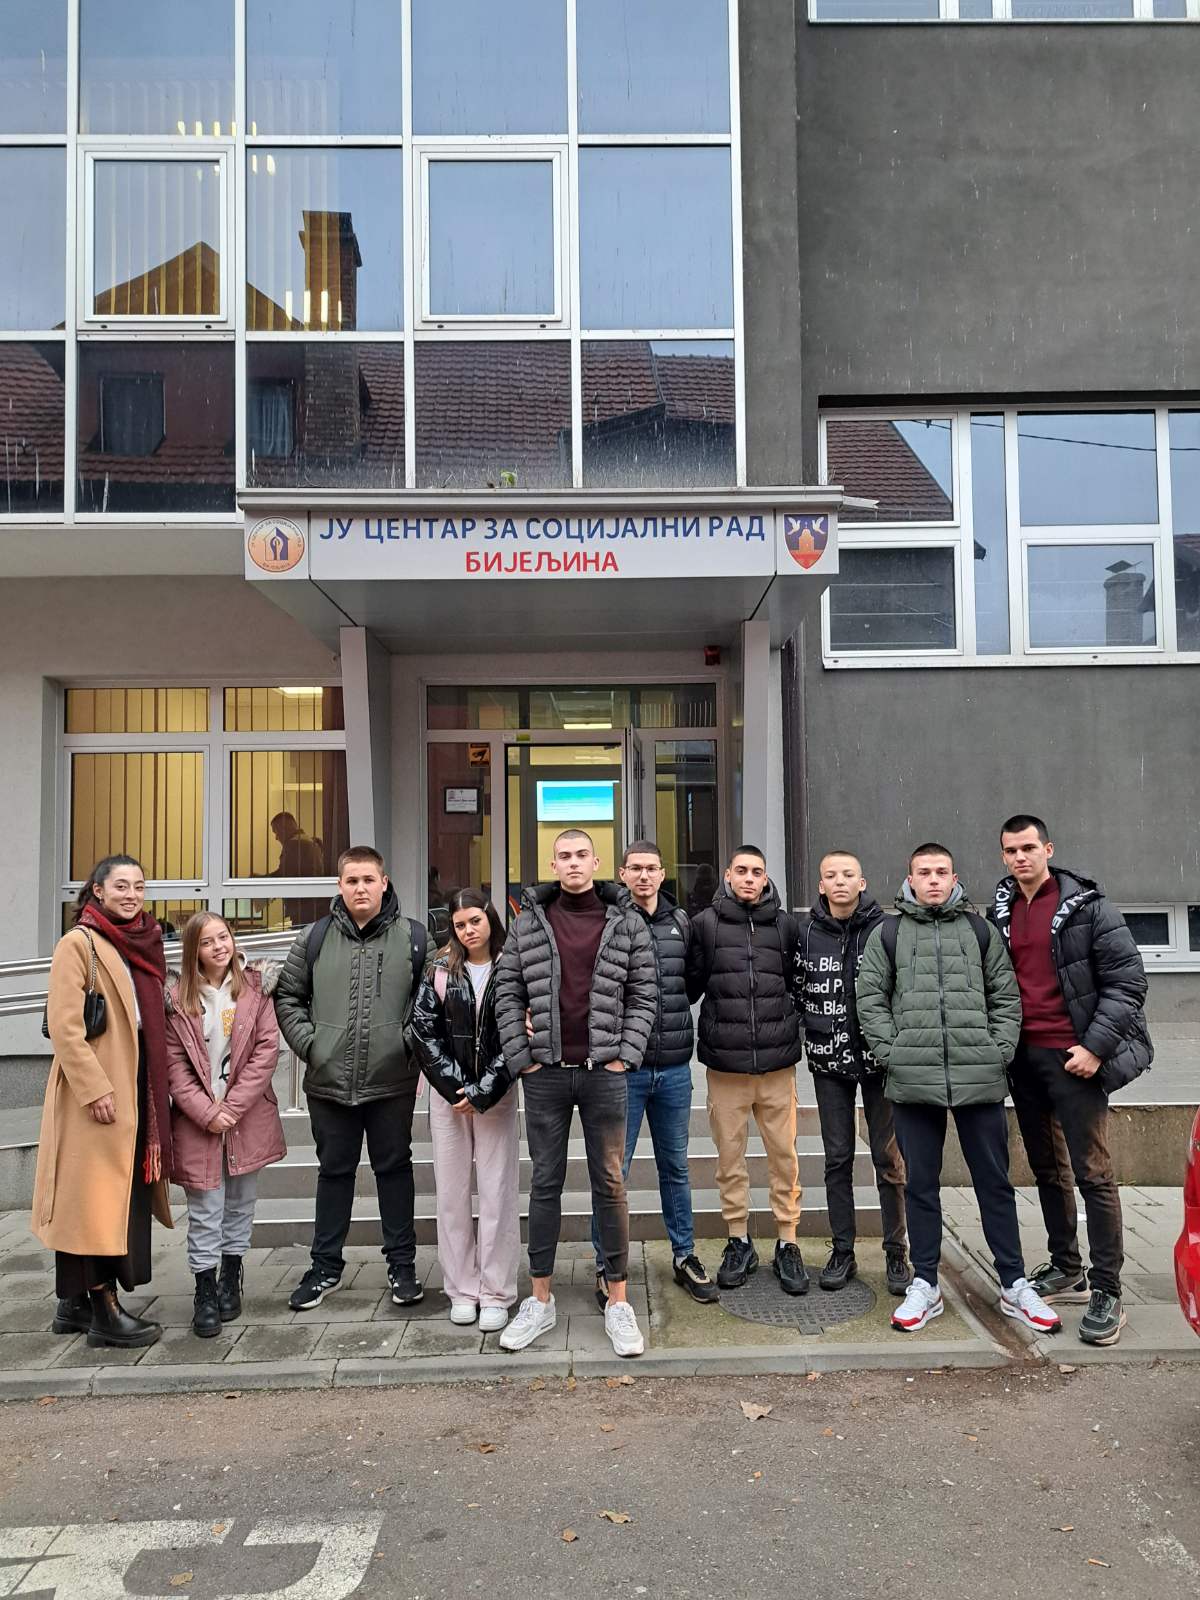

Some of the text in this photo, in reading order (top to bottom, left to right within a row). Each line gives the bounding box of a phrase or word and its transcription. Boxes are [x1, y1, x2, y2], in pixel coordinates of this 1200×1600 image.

[319, 515, 766, 544] ЈУ ЦЕНТАР ЗА СОЦИЈАЛНИ РАД
[465, 551, 620, 573] БИЈЕЉИНА
